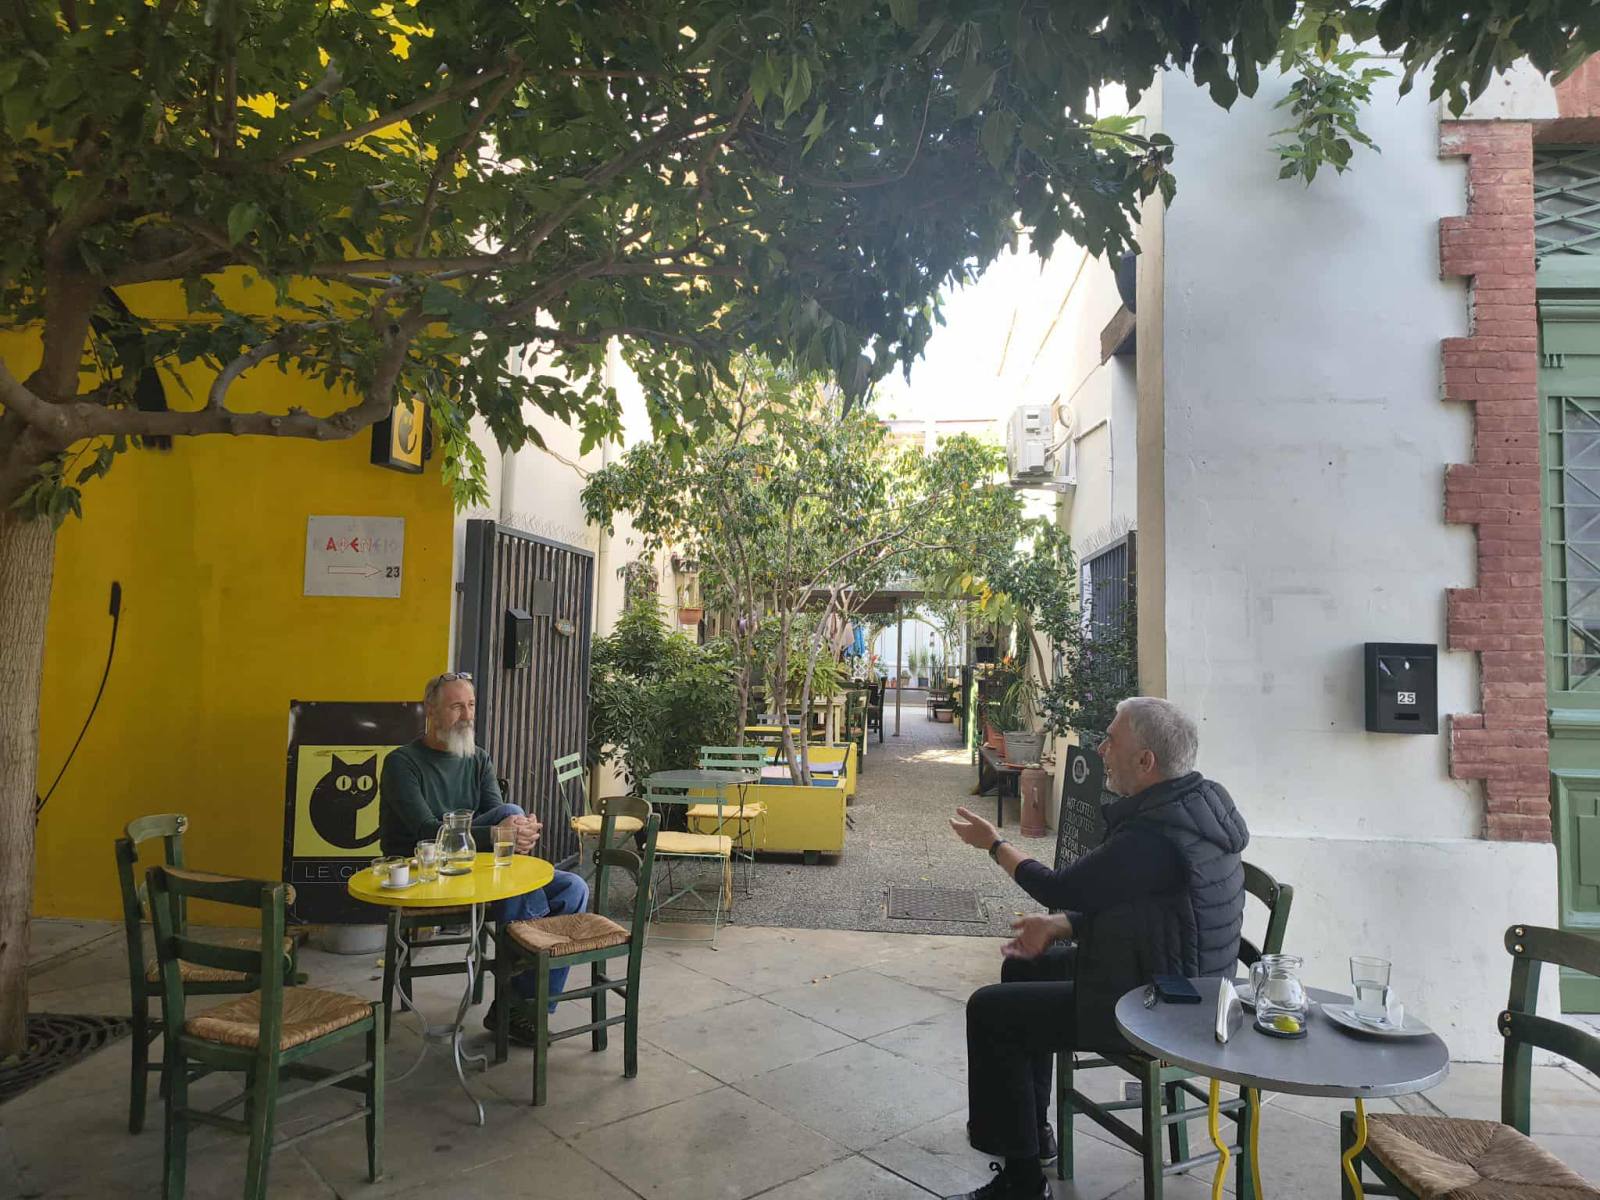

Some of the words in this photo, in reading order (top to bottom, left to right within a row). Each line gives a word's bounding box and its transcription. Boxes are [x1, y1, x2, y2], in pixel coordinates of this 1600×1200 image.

[385, 566, 400, 578] 23
[1399, 693, 1415, 703] 25
[305, 865, 330, 879] LE
